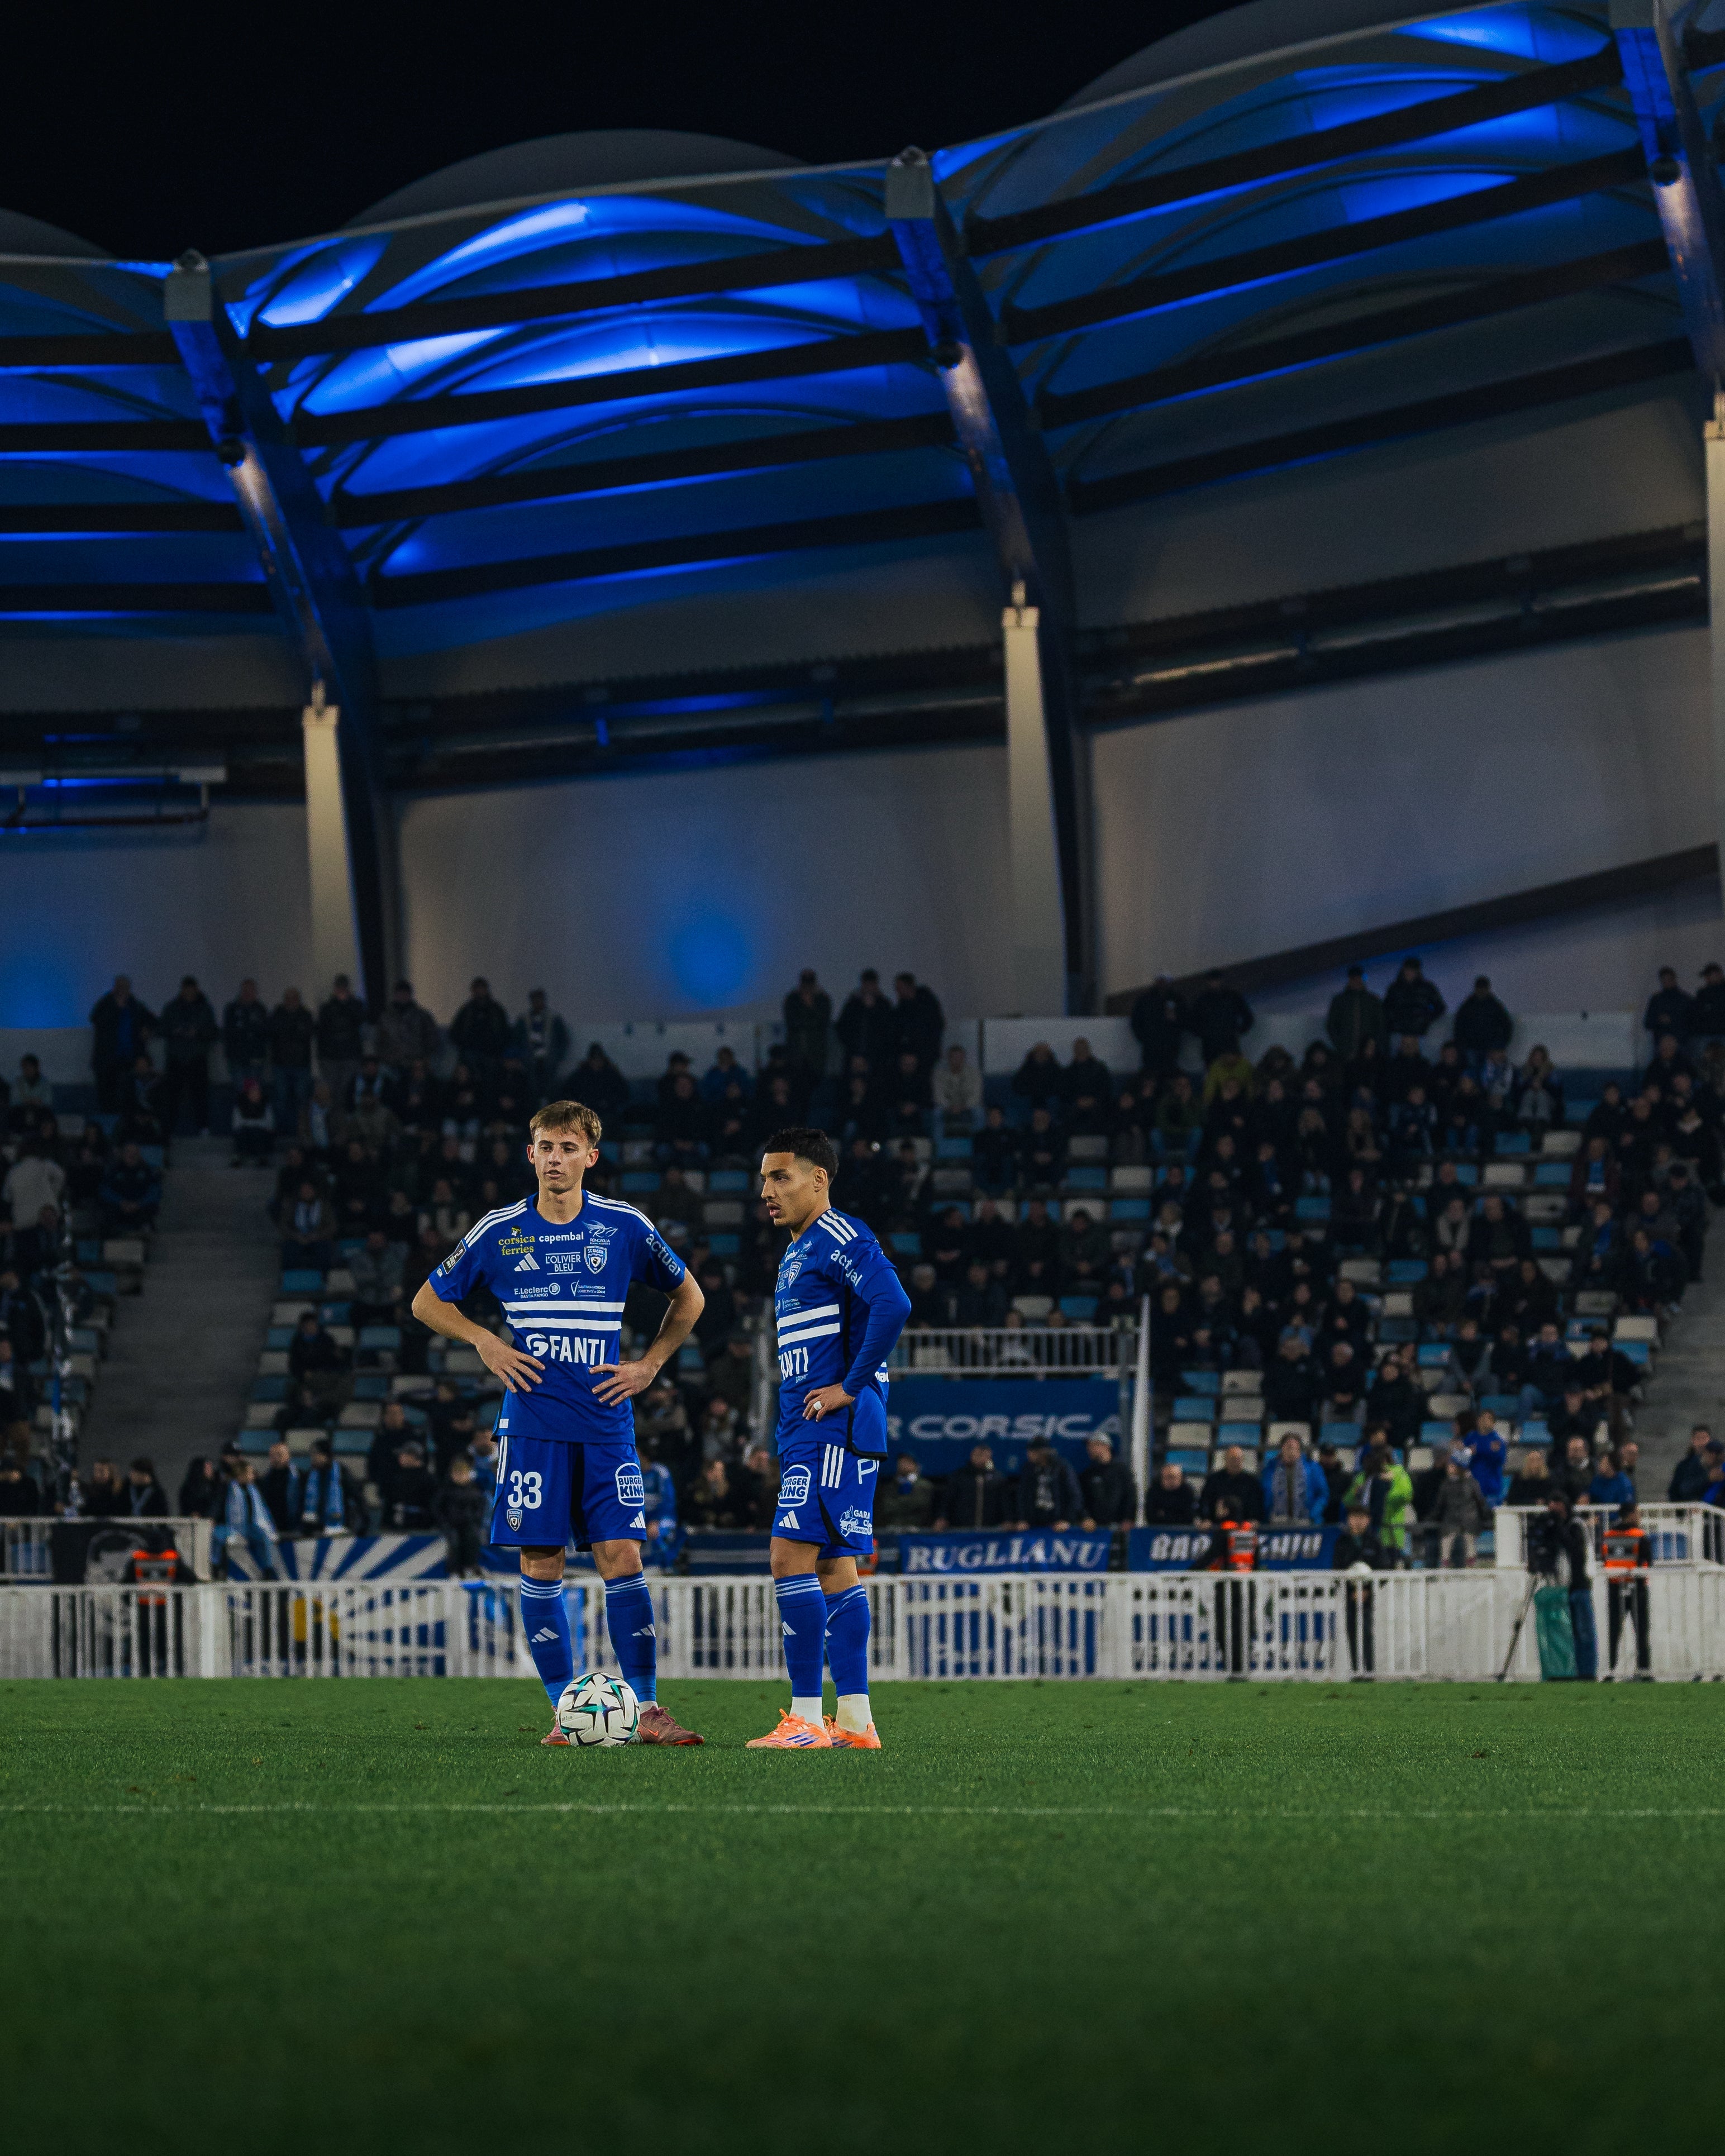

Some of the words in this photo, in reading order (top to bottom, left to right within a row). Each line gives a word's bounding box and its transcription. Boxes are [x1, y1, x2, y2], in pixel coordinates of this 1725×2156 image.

[498, 1235, 535, 1246] corsica
[539, 1232, 584, 1244] capembal
[502, 1244, 534, 1256] ferries
[646, 1233, 680, 1276] actual
[554, 1263, 573, 1272] BLEU
[514, 1286, 549, 1295] E.Leclerc
[908, 1414, 1121, 1440] CORSICA
[508, 1470, 542, 1509] 33
[906, 1537, 1107, 1572] RUGLIANU
